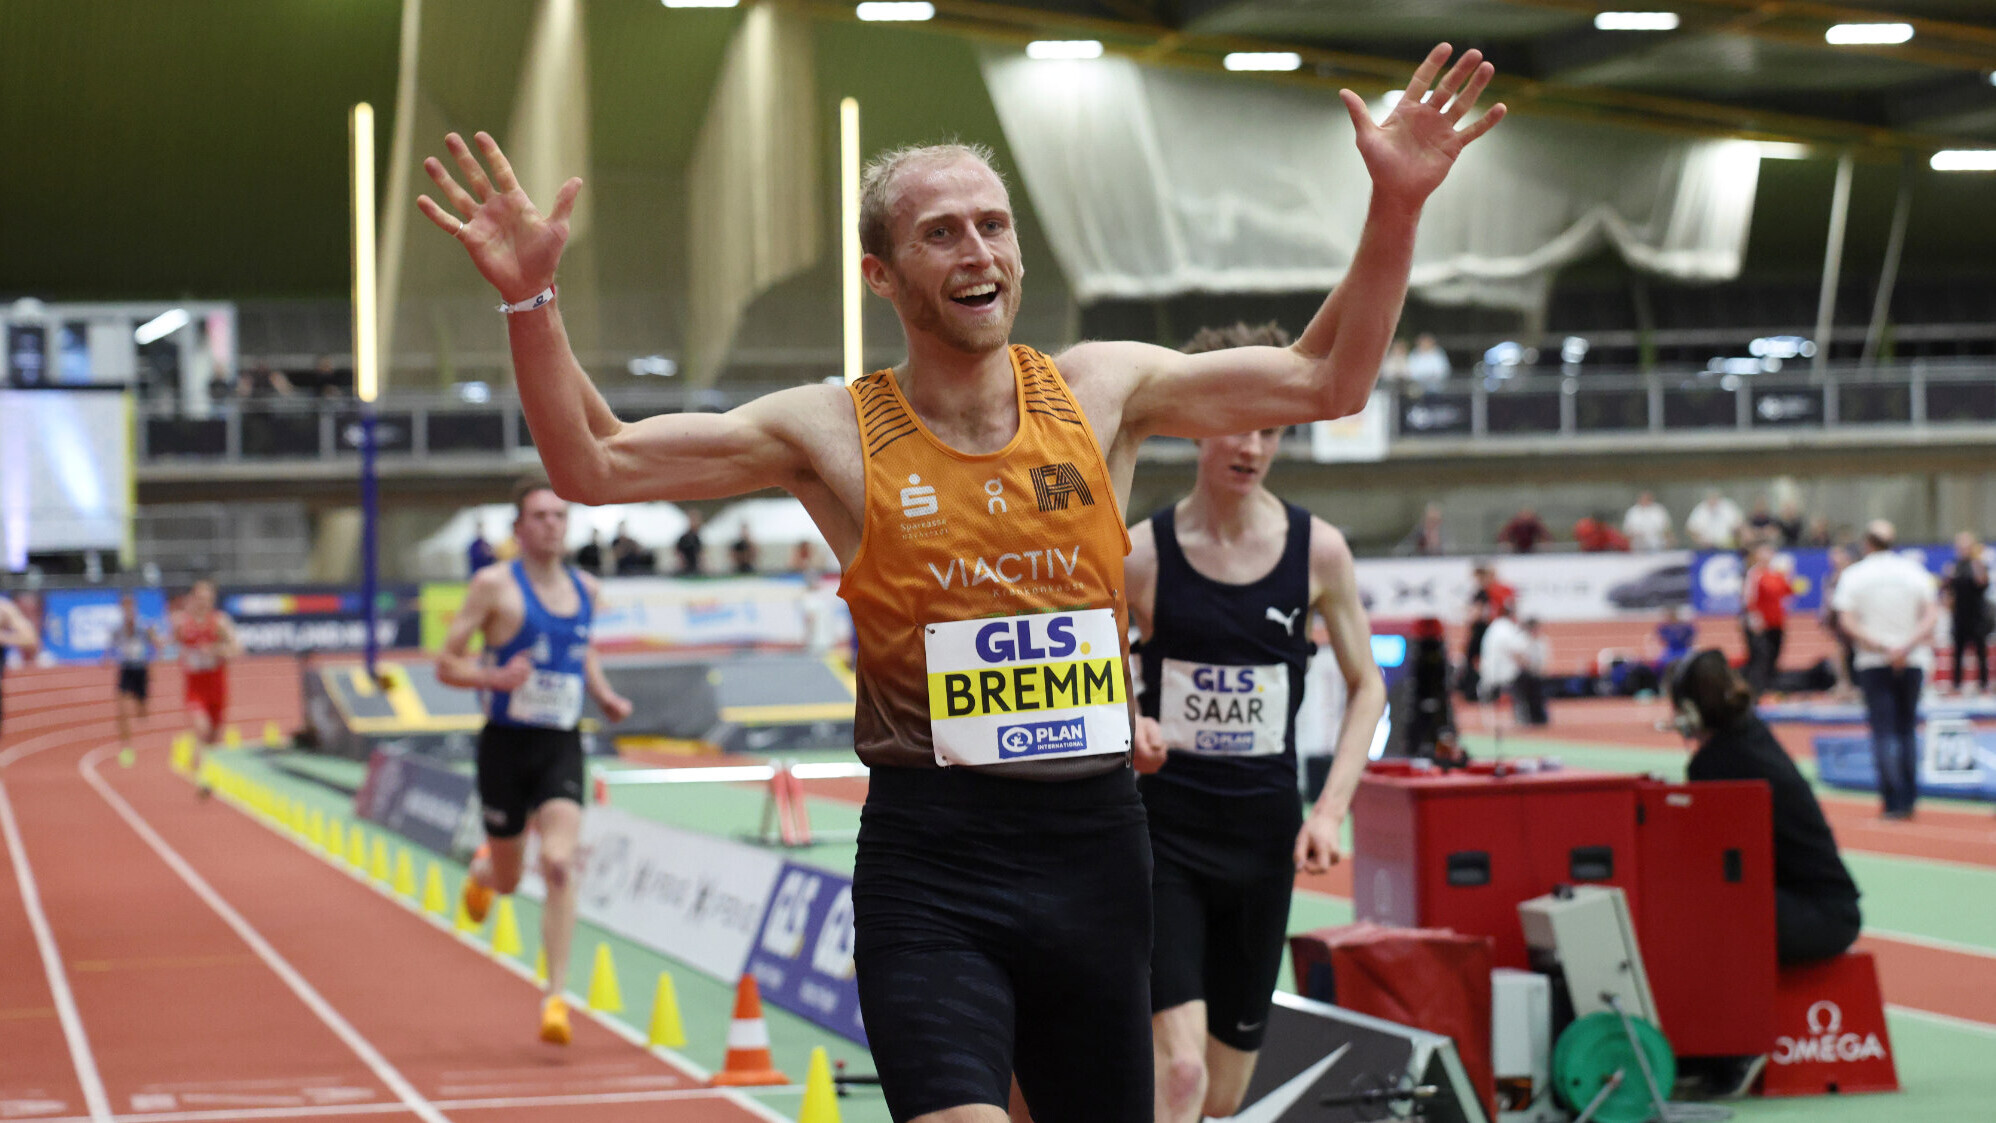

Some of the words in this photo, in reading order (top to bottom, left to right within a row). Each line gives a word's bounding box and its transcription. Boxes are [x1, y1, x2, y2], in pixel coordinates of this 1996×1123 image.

[927, 545, 1080, 591] VIACTIV
[944, 660, 1115, 718] BREMM
[1183, 693, 1264, 724] SAAR
[1036, 724, 1083, 743] PLAN
[1036, 740, 1085, 752] INTERNATIONAL
[1770, 1032, 1887, 1066] OMEGA
